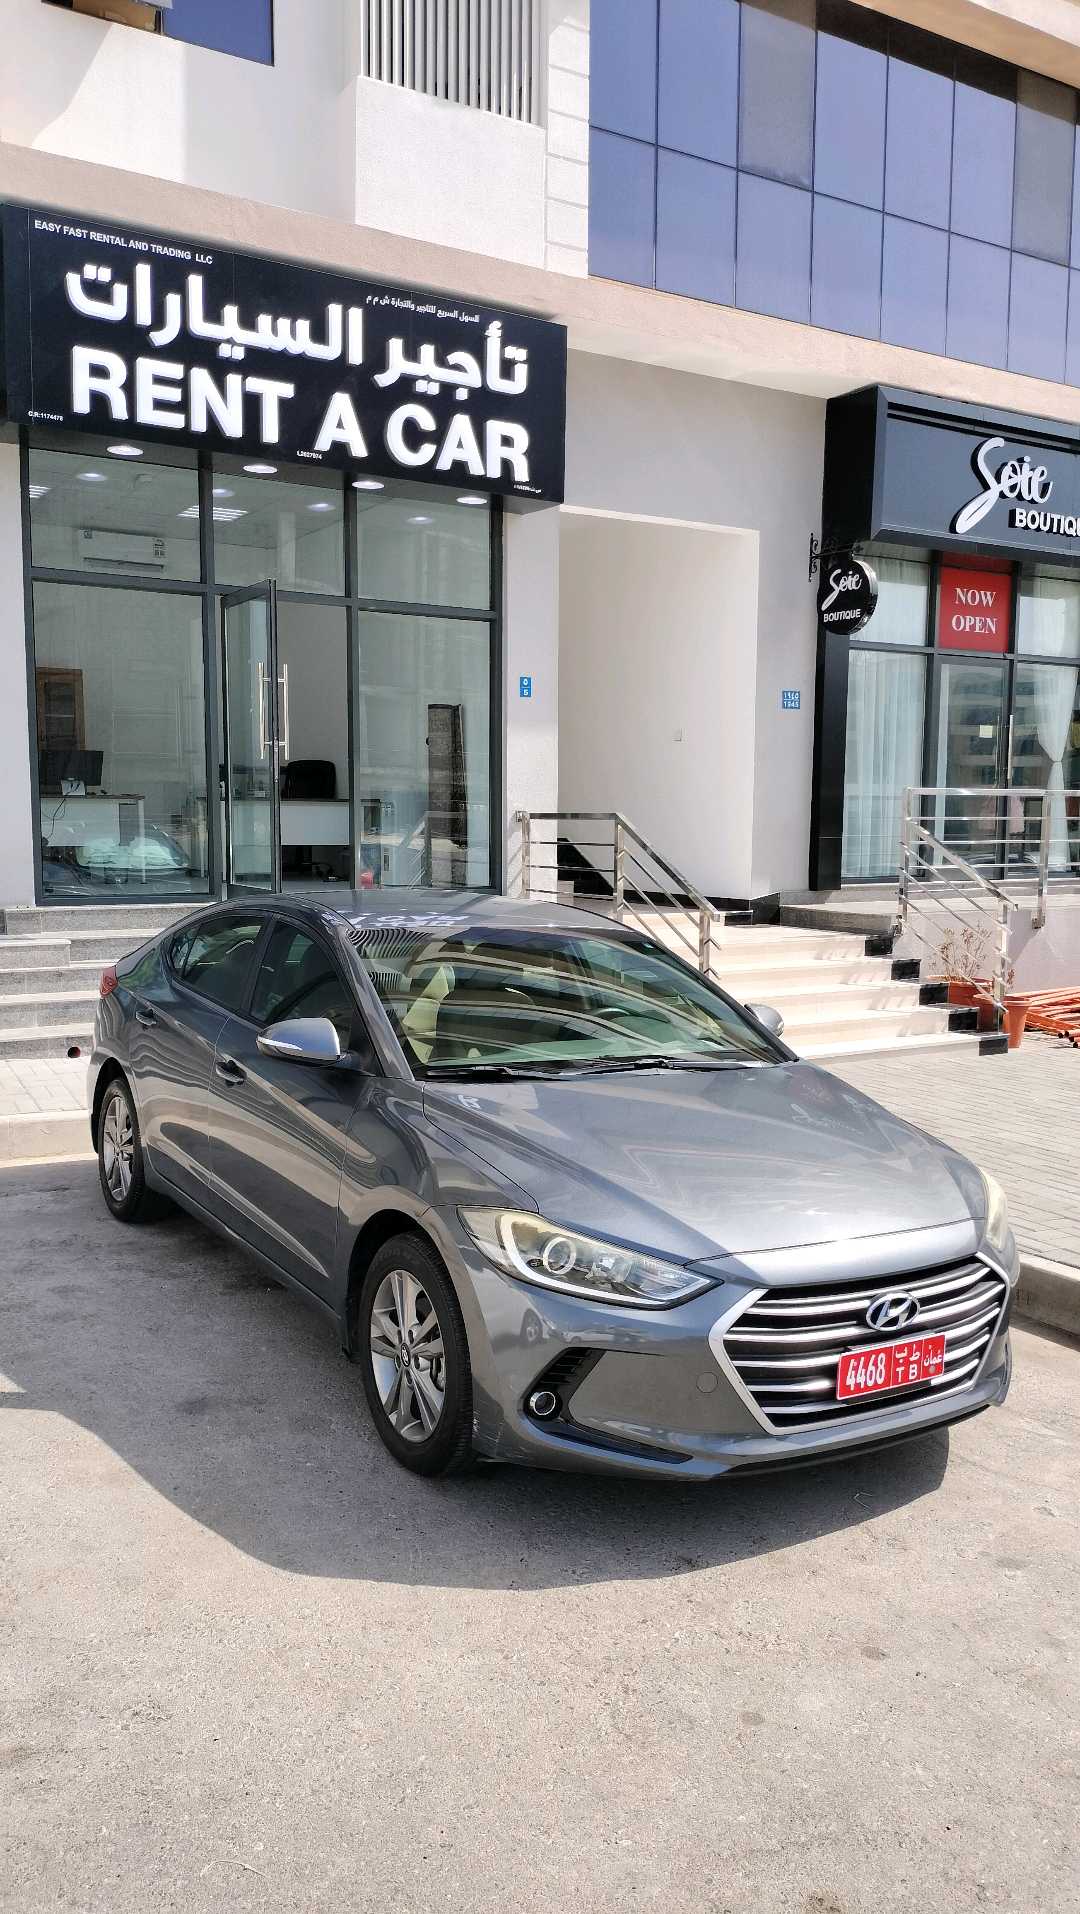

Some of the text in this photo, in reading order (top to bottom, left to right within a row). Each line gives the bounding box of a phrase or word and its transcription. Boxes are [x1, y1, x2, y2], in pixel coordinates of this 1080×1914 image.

[34, 219, 213, 265] EASY FAST RENTAL AND TRADING LLC
[66, 263, 529, 400] تأجير السيارات
[71, 345, 530, 482] RENT A CAR
[955, 437, 1054, 534] Soie
[1015, 507, 1080, 537] BOUTIQ
[823, 608, 861, 623] BOUTIQUE
[953, 587, 997, 608] NOW
[951, 614, 998, 634] OPEN
[846, 1352, 886, 1391] 4468
